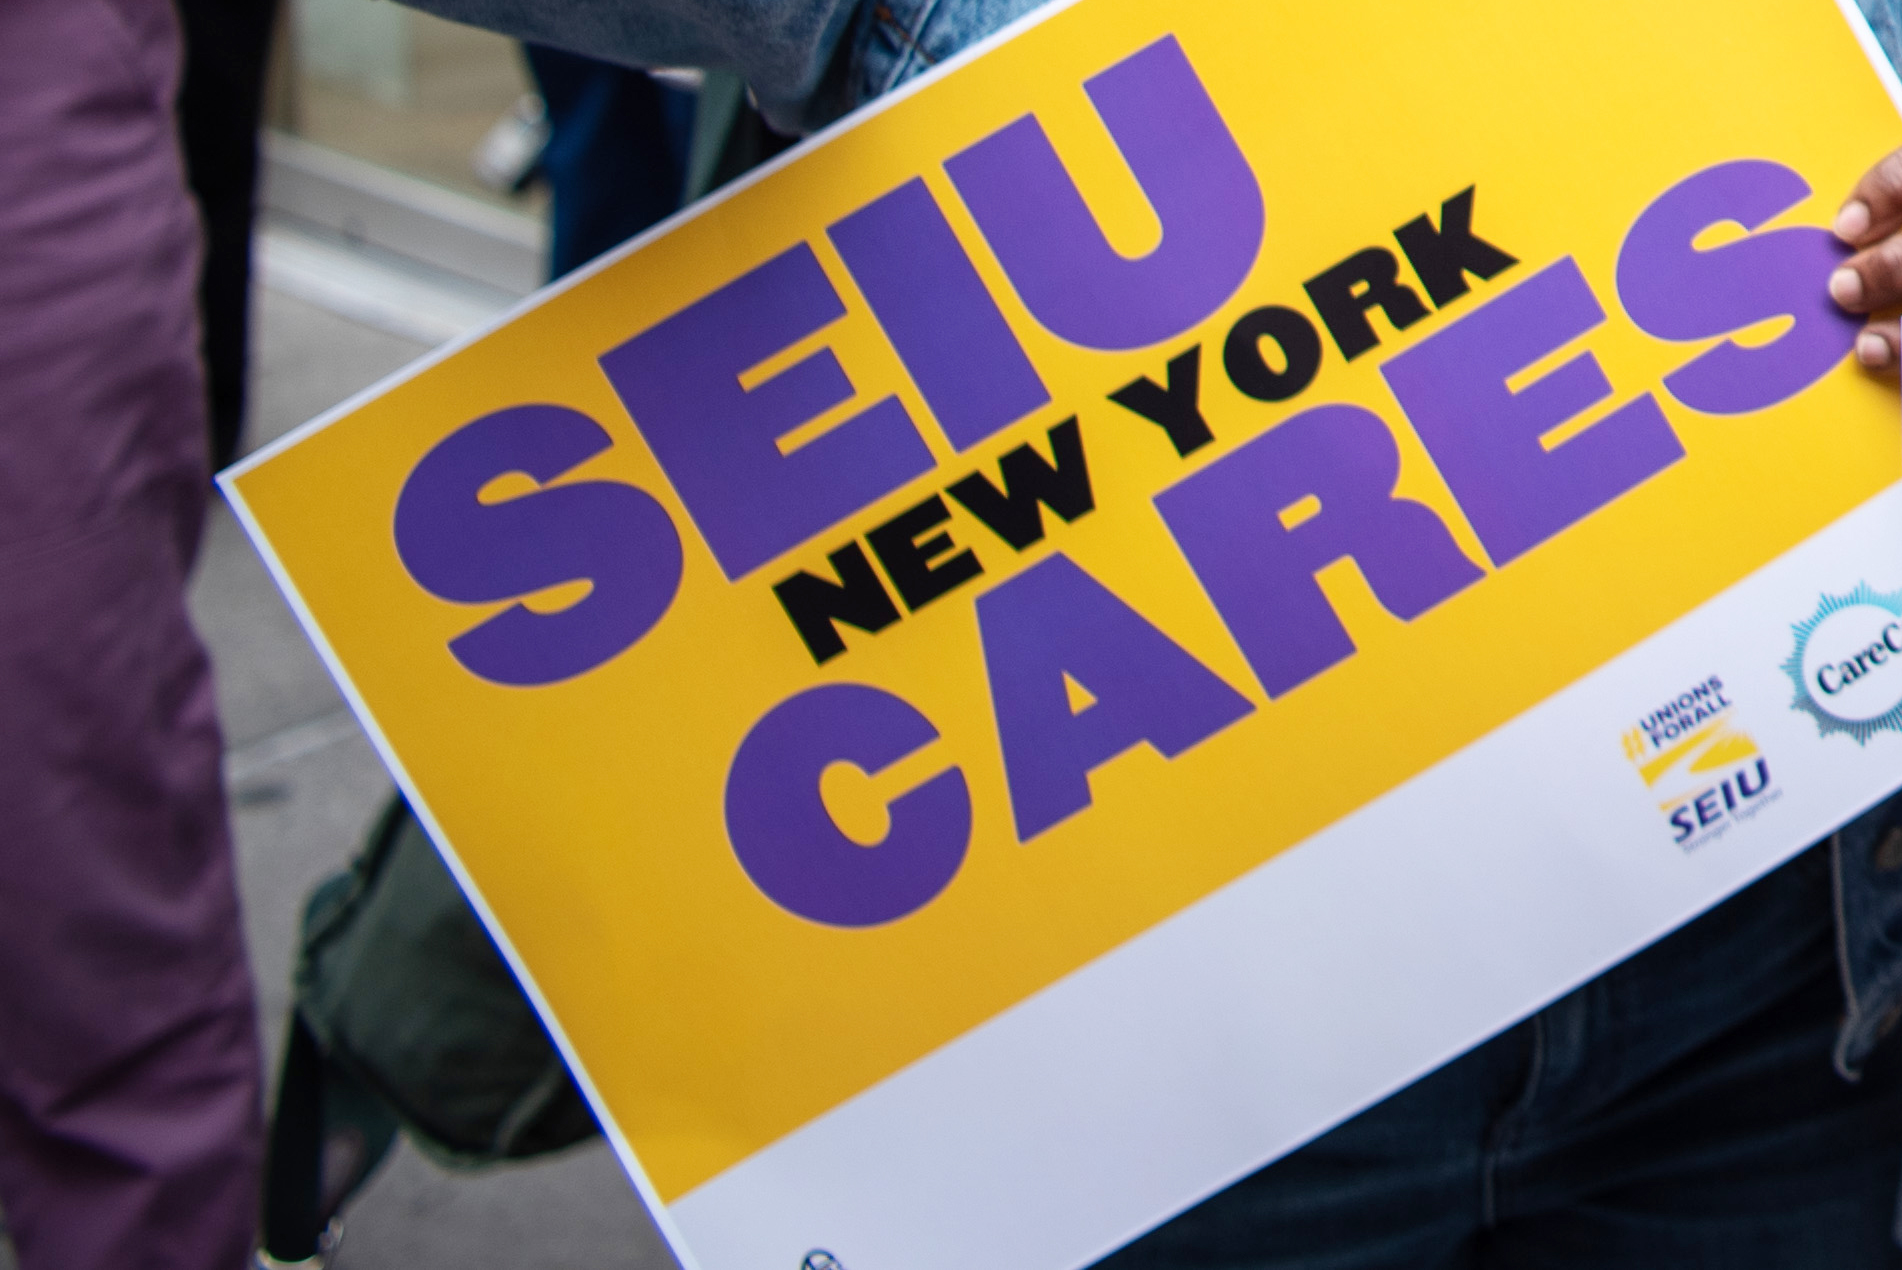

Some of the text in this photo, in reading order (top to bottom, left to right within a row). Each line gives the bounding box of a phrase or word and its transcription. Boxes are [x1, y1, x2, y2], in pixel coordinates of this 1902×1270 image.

[394, 33, 1265, 688] SEIU
[723, 159, 1857, 929] CARES
[772, 184, 1522, 667] NEW YORK
[1650, 693, 1732, 750] FORALL
[1669, 757, 1771, 845] SEIU
